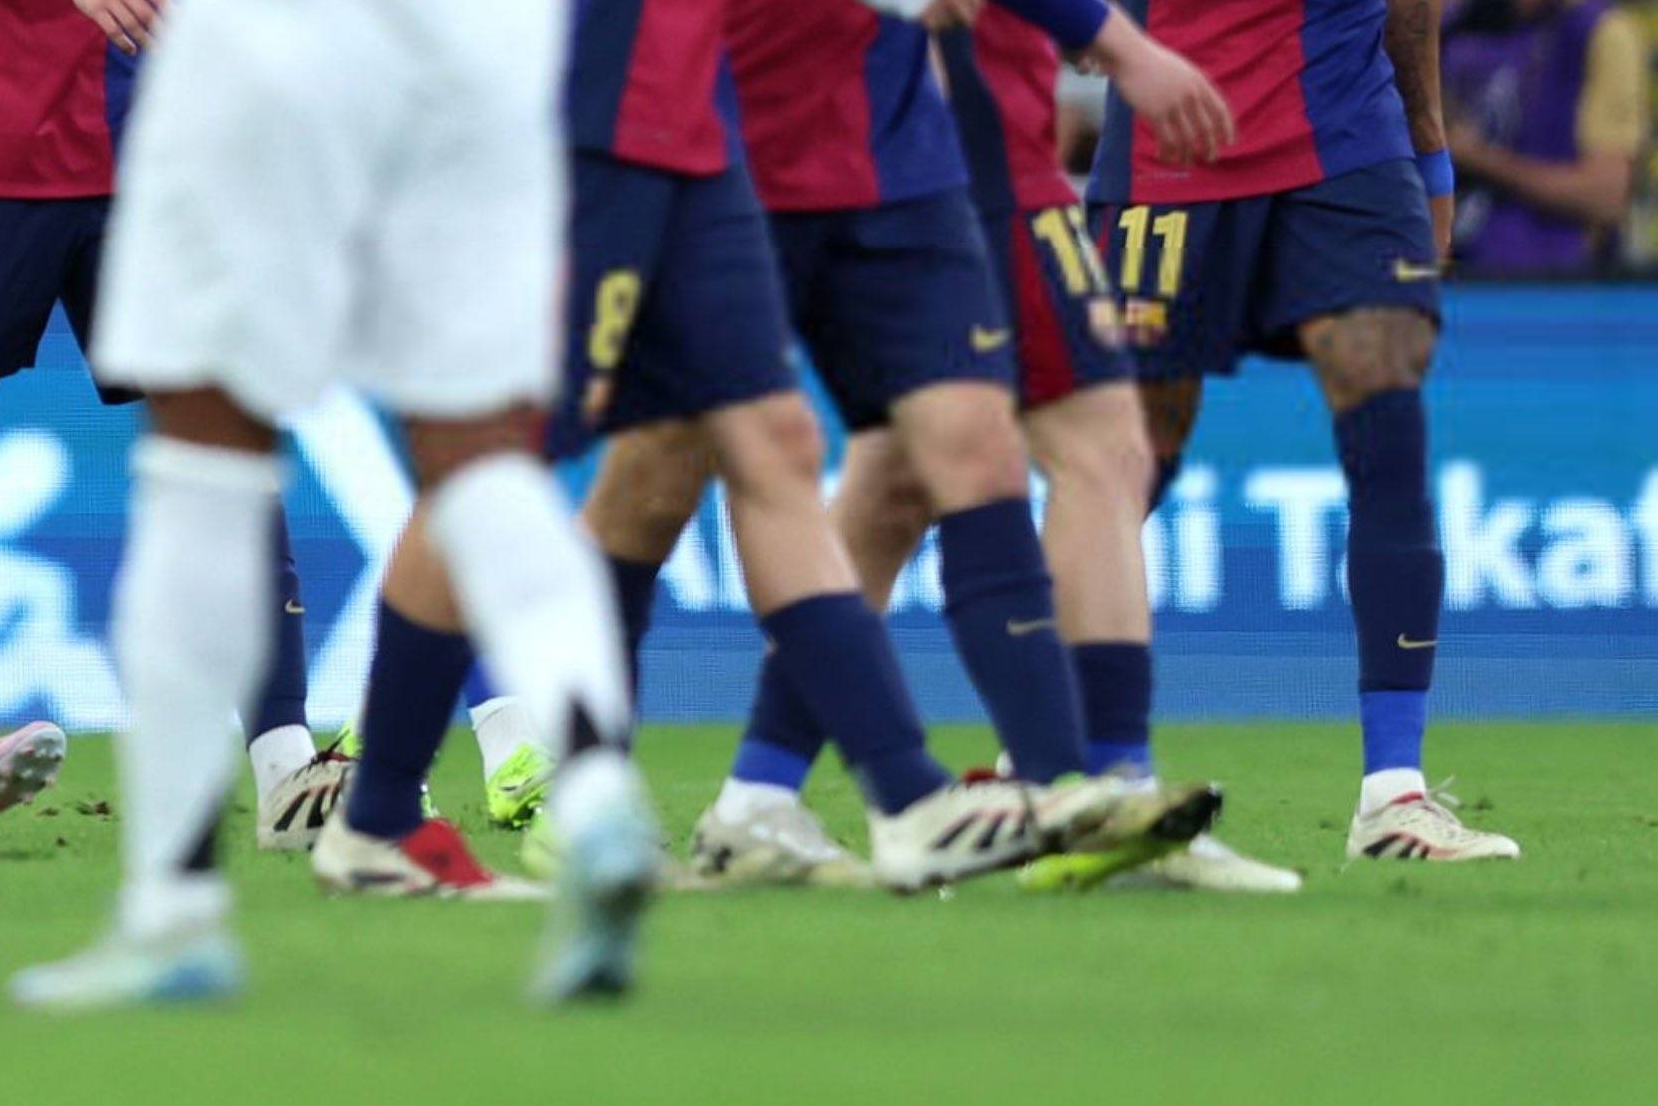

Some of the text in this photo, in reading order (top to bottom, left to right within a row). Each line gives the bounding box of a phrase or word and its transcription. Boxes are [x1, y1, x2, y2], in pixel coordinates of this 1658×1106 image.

[1118, 204, 1189, 298] 11
[588, 270, 642, 370] 8
[1244, 459, 1658, 612] Tka
